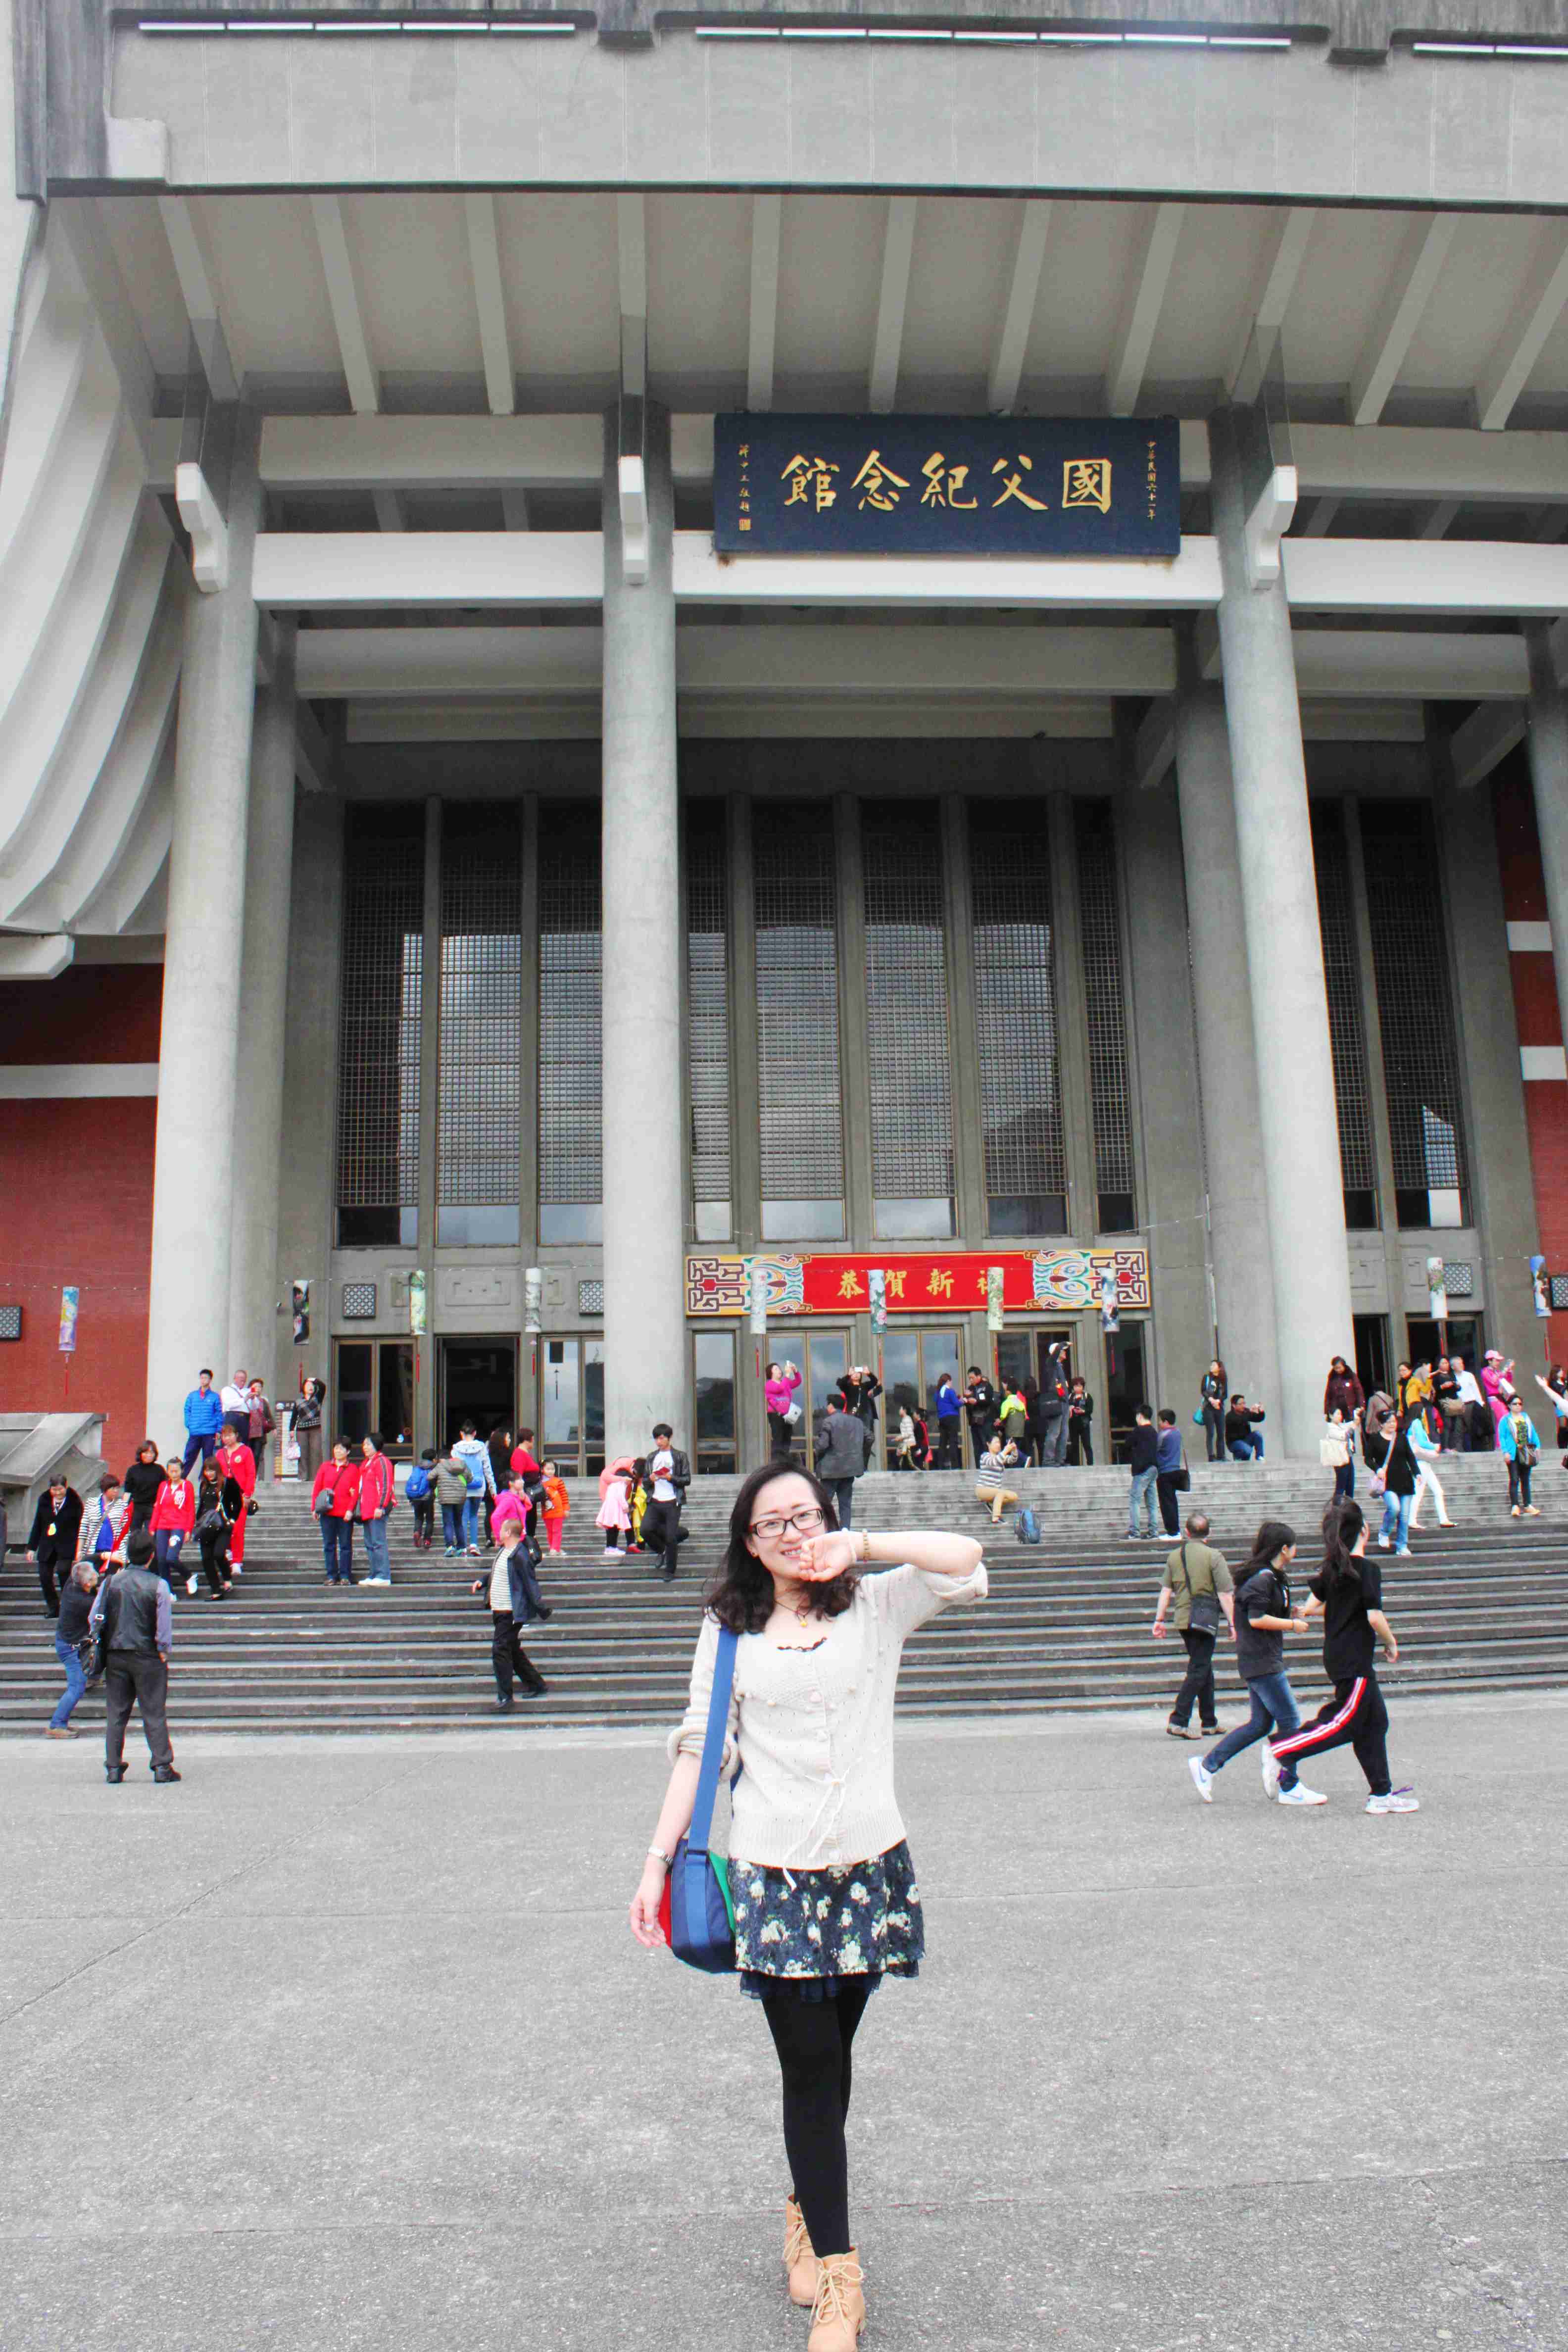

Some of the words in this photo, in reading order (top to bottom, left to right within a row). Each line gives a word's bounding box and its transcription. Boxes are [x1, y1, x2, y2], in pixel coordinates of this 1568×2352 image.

[781, 449, 1112, 514] 國父紀念館
